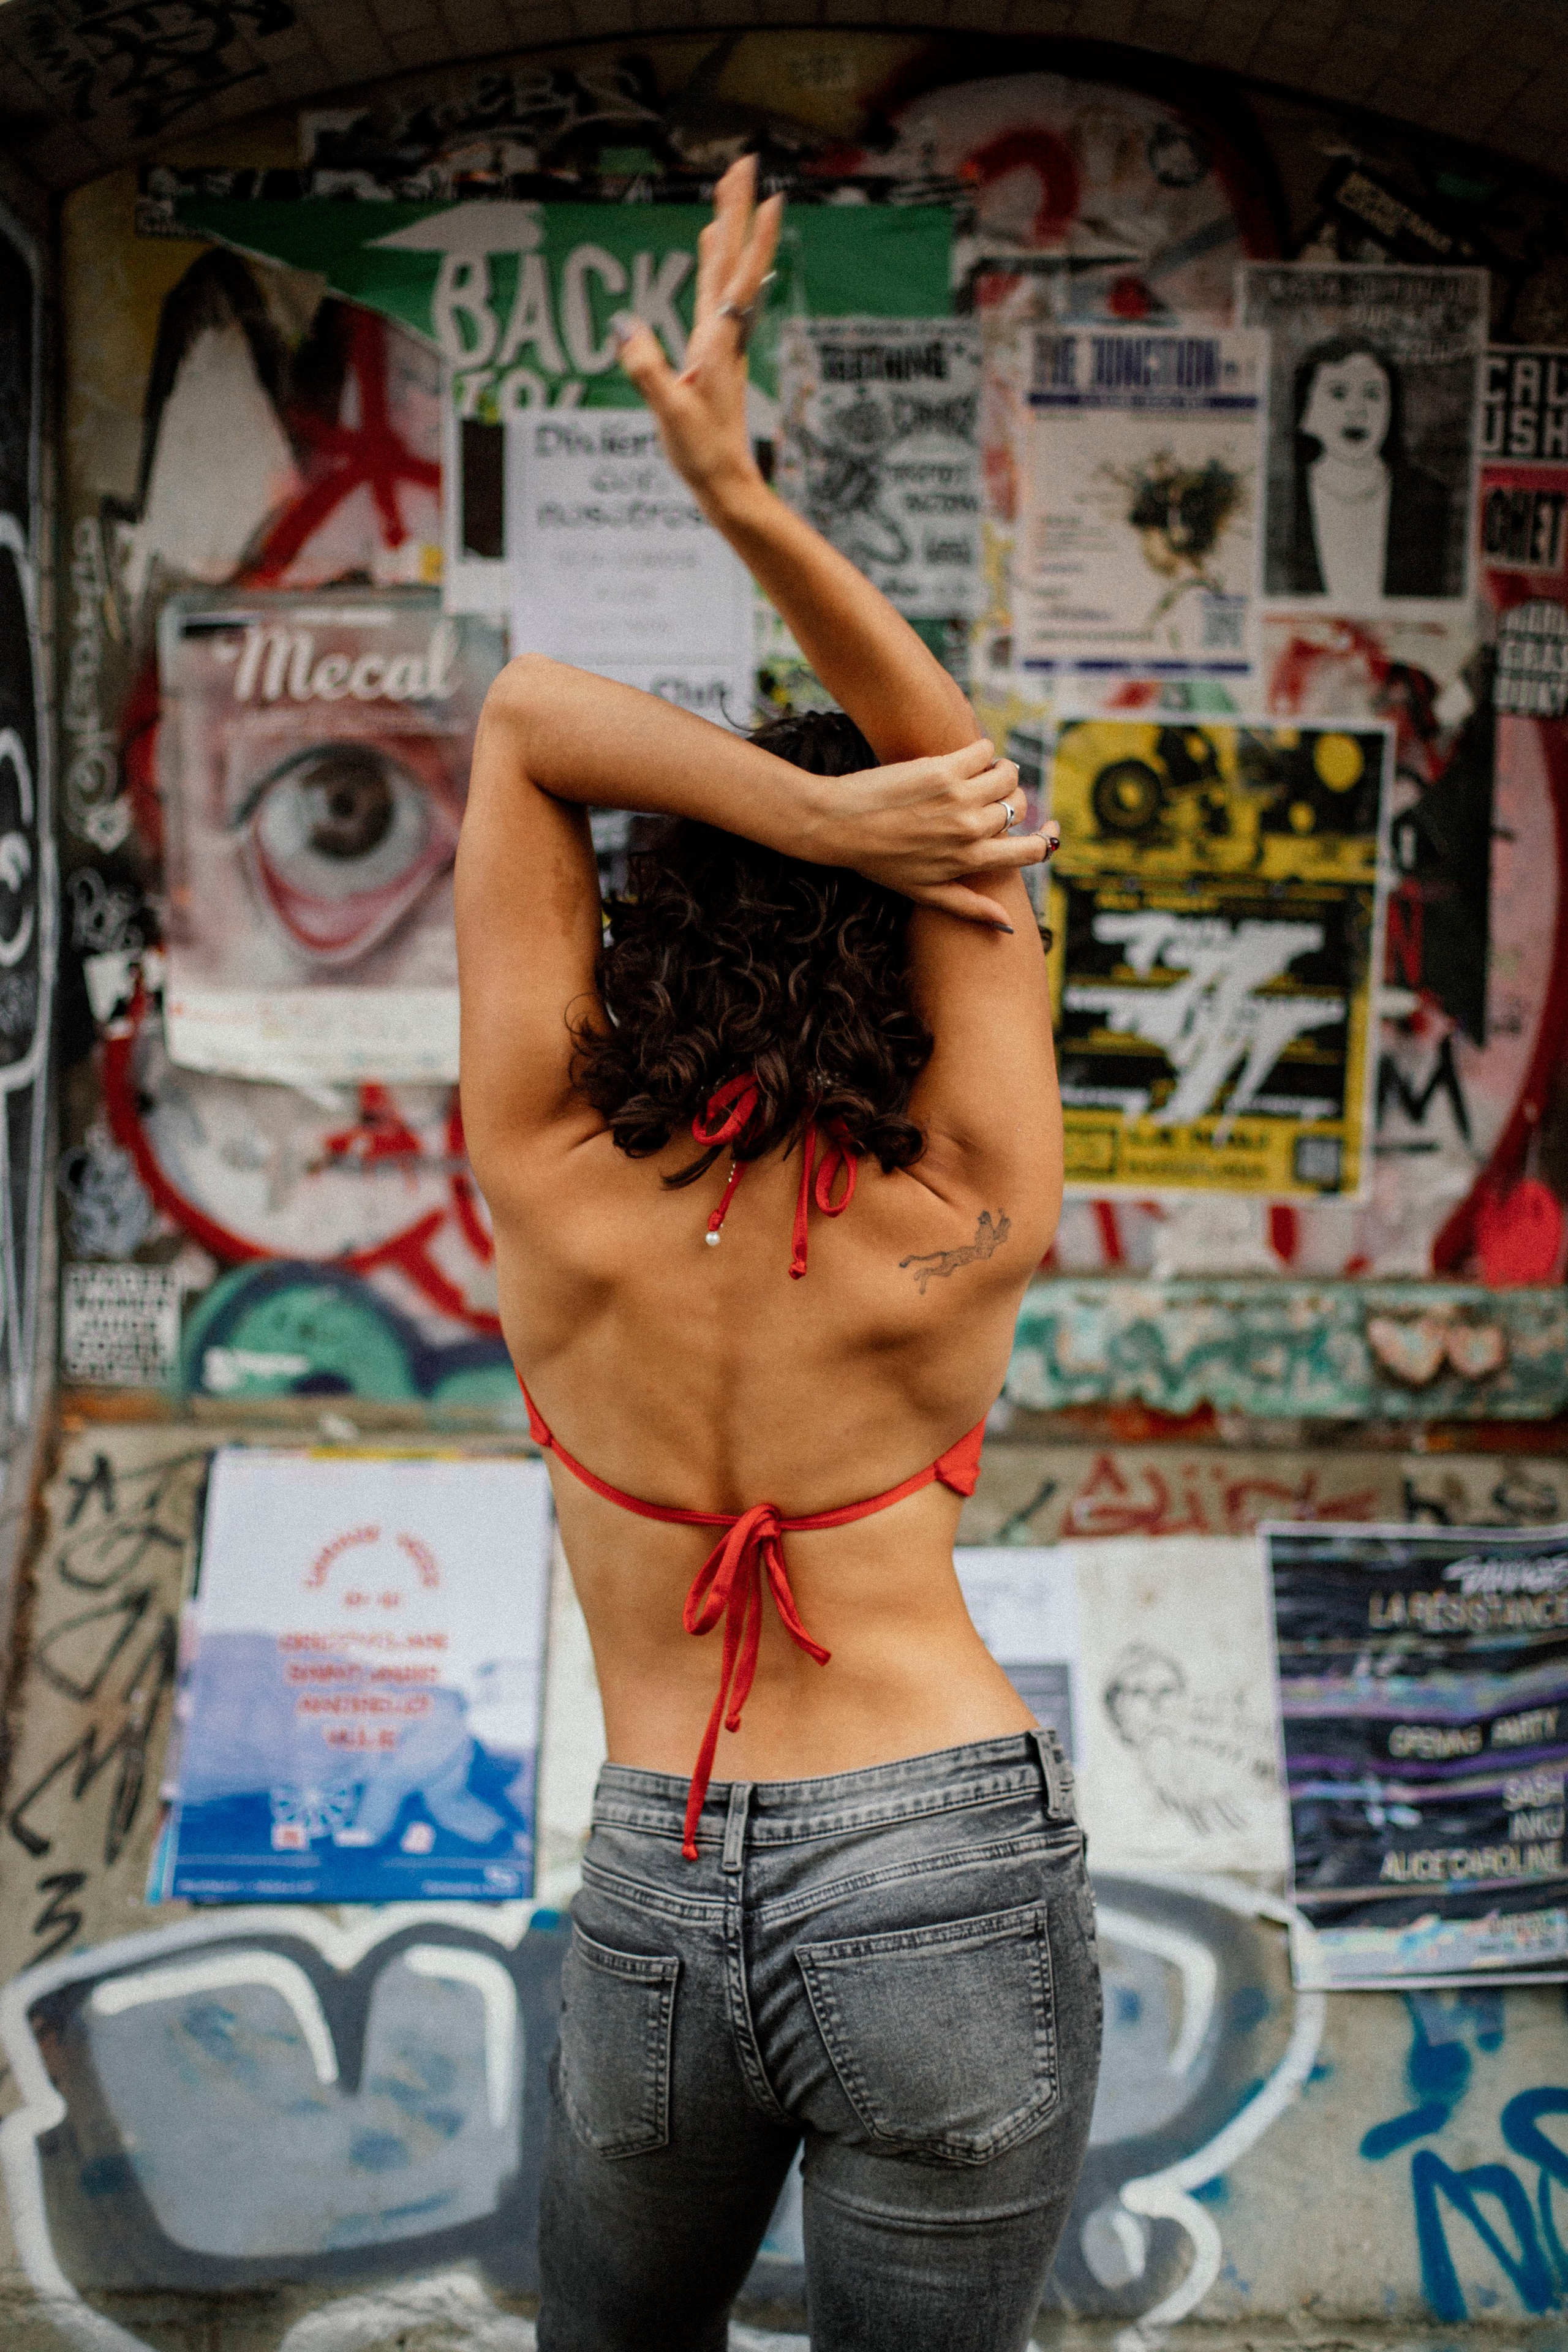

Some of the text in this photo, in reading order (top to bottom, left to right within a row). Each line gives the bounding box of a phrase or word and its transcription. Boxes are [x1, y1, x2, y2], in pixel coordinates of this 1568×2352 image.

[433, 245, 695, 375] BACK
[214, 624, 462, 703] Mecal
[1491, 1708, 1558, 1747] PARTY
